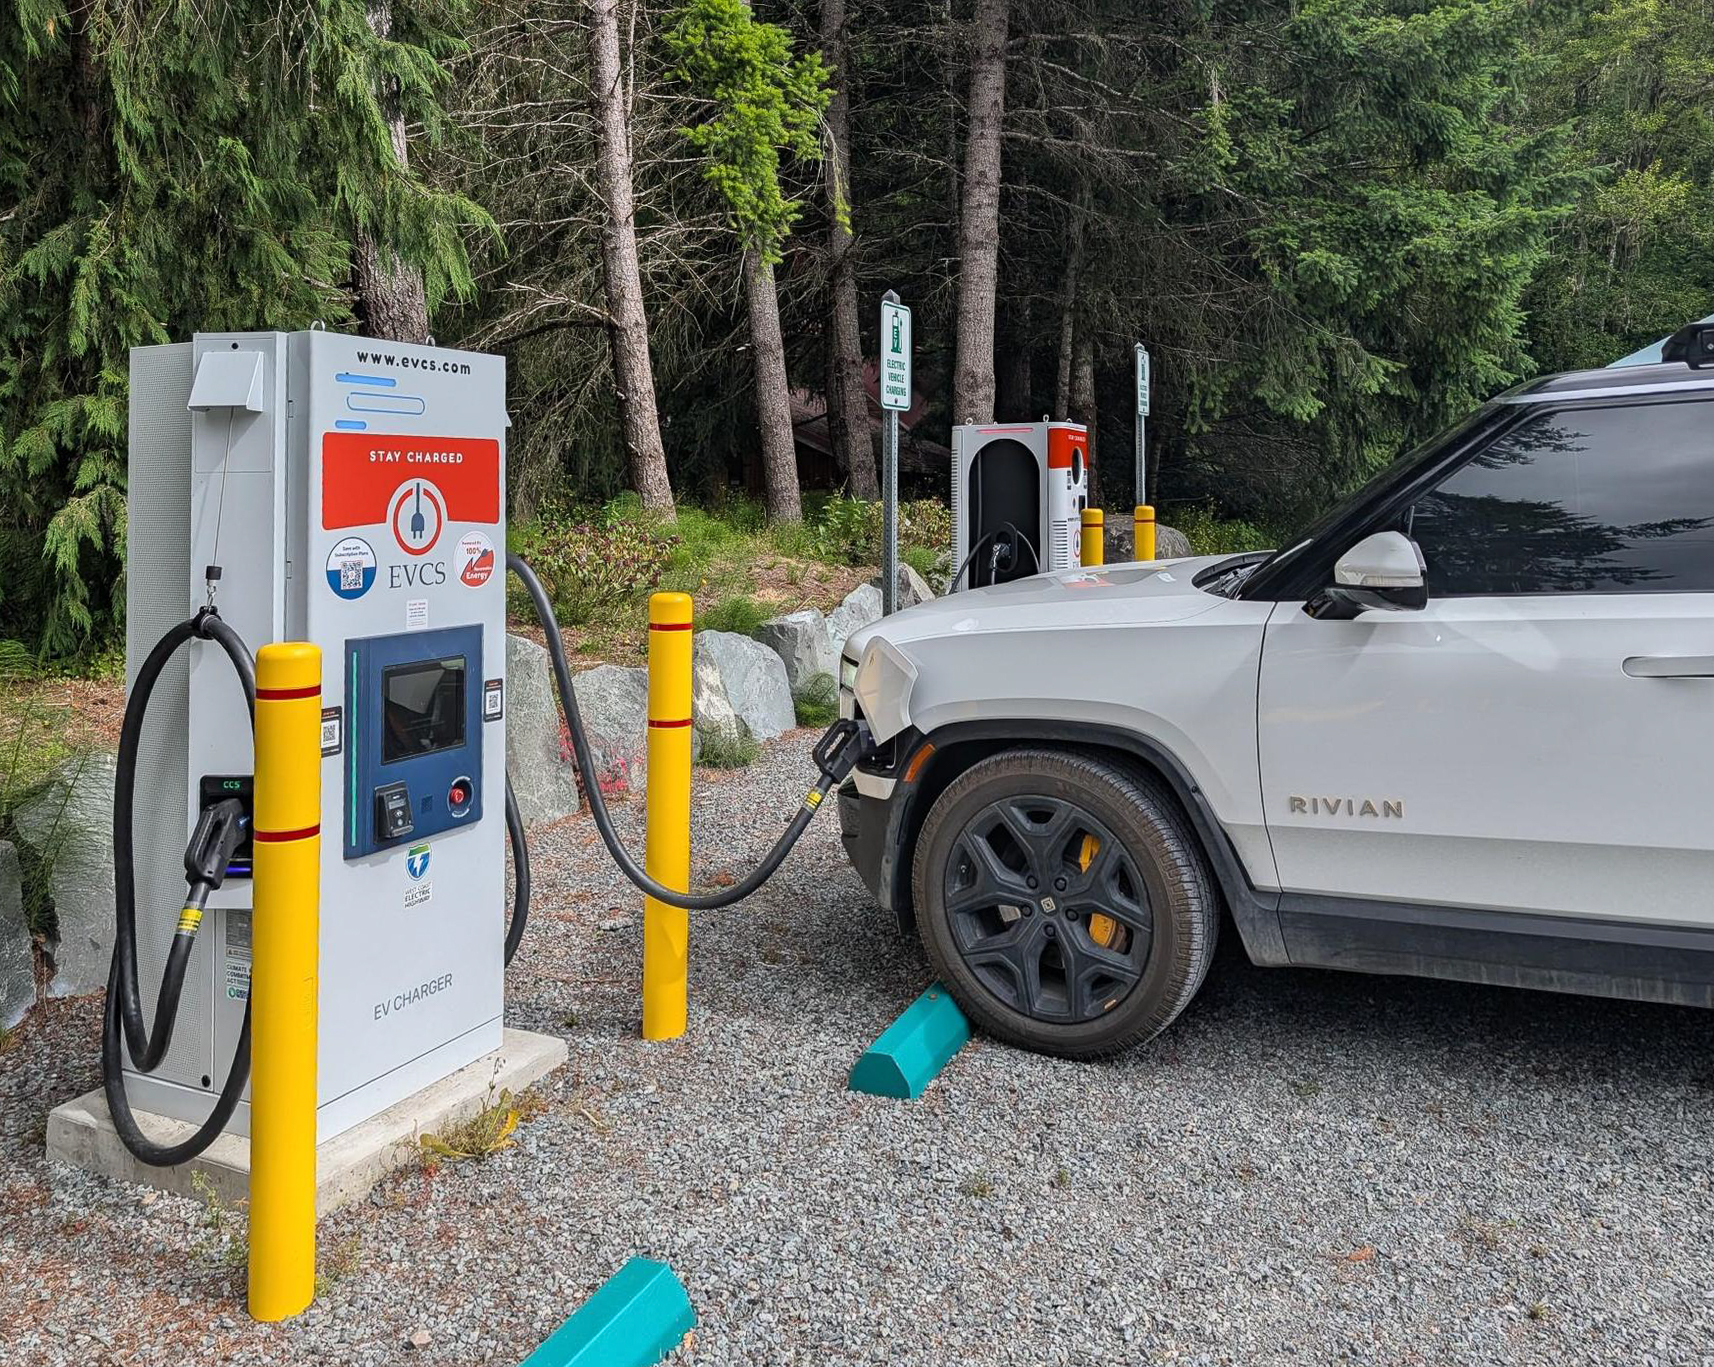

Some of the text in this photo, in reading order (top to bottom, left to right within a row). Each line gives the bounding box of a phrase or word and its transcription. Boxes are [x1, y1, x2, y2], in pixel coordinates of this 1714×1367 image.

[357, 351, 471, 375] www.evcs.com
[887, 359, 906, 371] ELECTRIC
[888, 372, 904, 383] VEHICLE
[886, 385, 906, 396] CHARGING
[370, 450, 463, 463] STAY CHARGED
[466, 547, 482, 555] 100%
[389, 562, 446, 589] EVCS
[466, 571, 488, 580] Energy
[223, 781, 240, 789] CCS
[1290, 796, 1403, 818] RIVIAN
[405, 887, 430, 902] ELECTRIC
[227, 964, 247, 973] CLIMATE
[374, 973, 452, 1020] EV CHARGER
